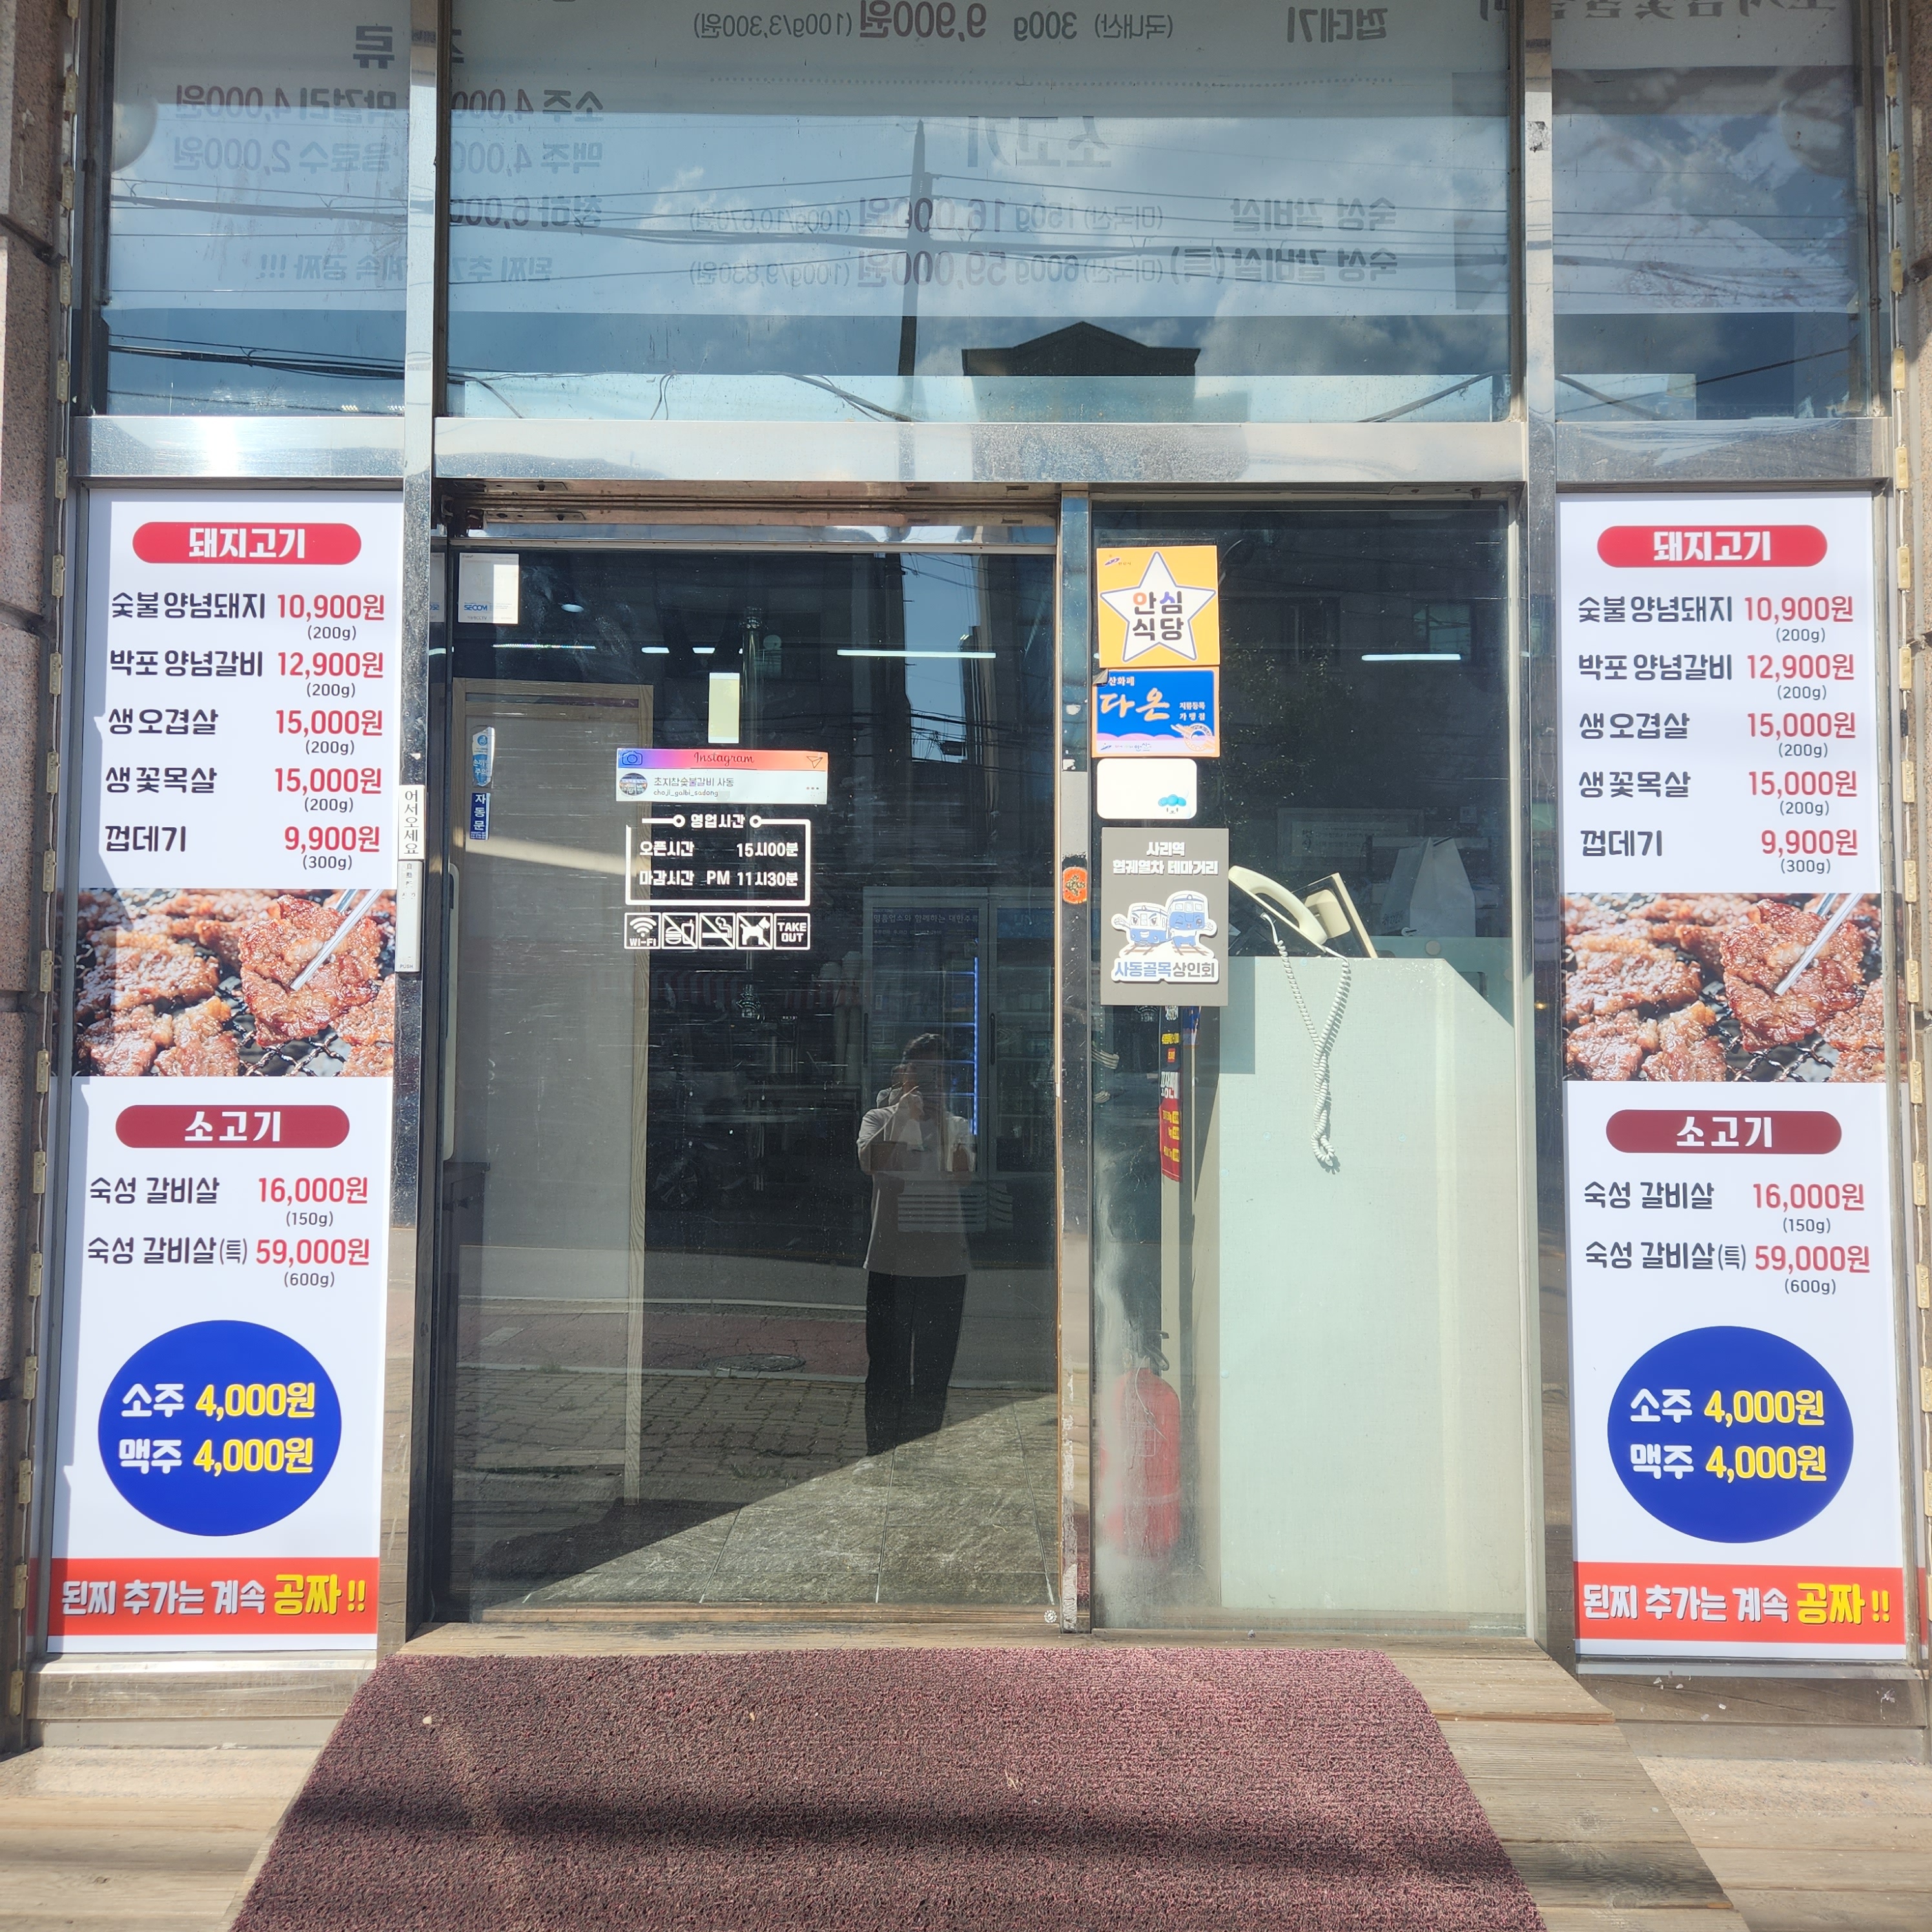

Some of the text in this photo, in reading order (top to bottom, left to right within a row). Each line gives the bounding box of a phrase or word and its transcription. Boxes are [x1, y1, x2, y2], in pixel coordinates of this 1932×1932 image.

[189, 528, 305, 559] 돼지고기
[1653, 531, 1771, 561] 돼지고기
[278, 594, 384, 622] 10,900원
[1133, 591, 1182, 615] 안심
[1745, 596, 1853, 624] 10,900원
[308, 625, 356, 641] (200g)
[1132, 617, 1184, 641] 식당
[1776, 628, 1825, 643] (200g)
[278, 652, 384, 679] 12,900원
[1747, 654, 1855, 683] 12,900원
[307, 683, 355, 698] (200g)
[1778, 685, 1827, 701] (200g)
[276, 710, 382, 737] 15,000원
[1748, 712, 1856, 741] 15,000원
[305, 740, 355, 755] (200g)
[694, 751, 755, 765] Instagram
[1779, 743, 1828, 758] (200g)
[275, 768, 381, 796] 15,000원
[653, 777, 734, 788] 초지참숯불갈비 사동
[653, 788, 719, 797] choji_galbi_sadong
[1749, 771, 1858, 799] 15,000원
[304, 797, 354, 813] (200g)
[473, 794, 486, 830] 자동문
[1780, 801, 1829, 816] (200g)
[404, 789, 420, 855] 어서오세요
[690, 814, 746, 829] 영업시간
[105, 826, 380, 854] 껍데기 9,900원
[639, 841, 799, 858] 오픈시간 15시00분
[1146, 841, 1186, 857] 사리역
[1581, 830, 1858, 859] 껍데기 9,900원
[303, 855, 353, 870] (300g)
[1167, 860, 1219, 876] 테마거리
[1781, 859, 1831, 874] (300g)
[639, 870, 799, 887] 마감시간 PM 11시30분
[777, 921, 807, 932] TAKE
[781, 933, 804, 943] OUT
[629, 938, 657, 947] WI-FI
[184, 1110, 282, 1142] 소고기
[1676, 1116, 1774, 1149] 소고기
[90, 1177, 368, 1206] 숙성 갈비살 16,000원
[1585, 1182, 1865, 1212] 숙성 갈비살 16,000원
[287, 1211, 333, 1227] (150g)
[1783, 1218, 1831, 1233] (150g)
[88, 1237, 369, 1268] 숙성 갈비살(특) 59,000원
[1586, 1241, 1870, 1274] 숙성 갈비살(특) 59,000원
[284, 1271, 335, 1288] (600g)
[1785, 1279, 1836, 1295] (600g)
[121, 1382, 316, 1421] 소주 4,000원
[1630, 1388, 1825, 1428] 소주 4,000원
[118, 1438, 314, 1477] 맥주 4,000원
[1630, 1444, 1828, 1485] 맥주 4,000원
[61, 1579, 117, 1616] 된찌
[123, 1581, 205, 1616] 추가는
[211, 1579, 265, 1616] 계속
[273, 1574, 342, 1617] 공짜
[1583, 1585, 1639, 1621] 된찌
[1645, 1586, 1727, 1623] 추가는
[1733, 1587, 1790, 1624] 계속
[1797, 1583, 1865, 1626] 공짜
